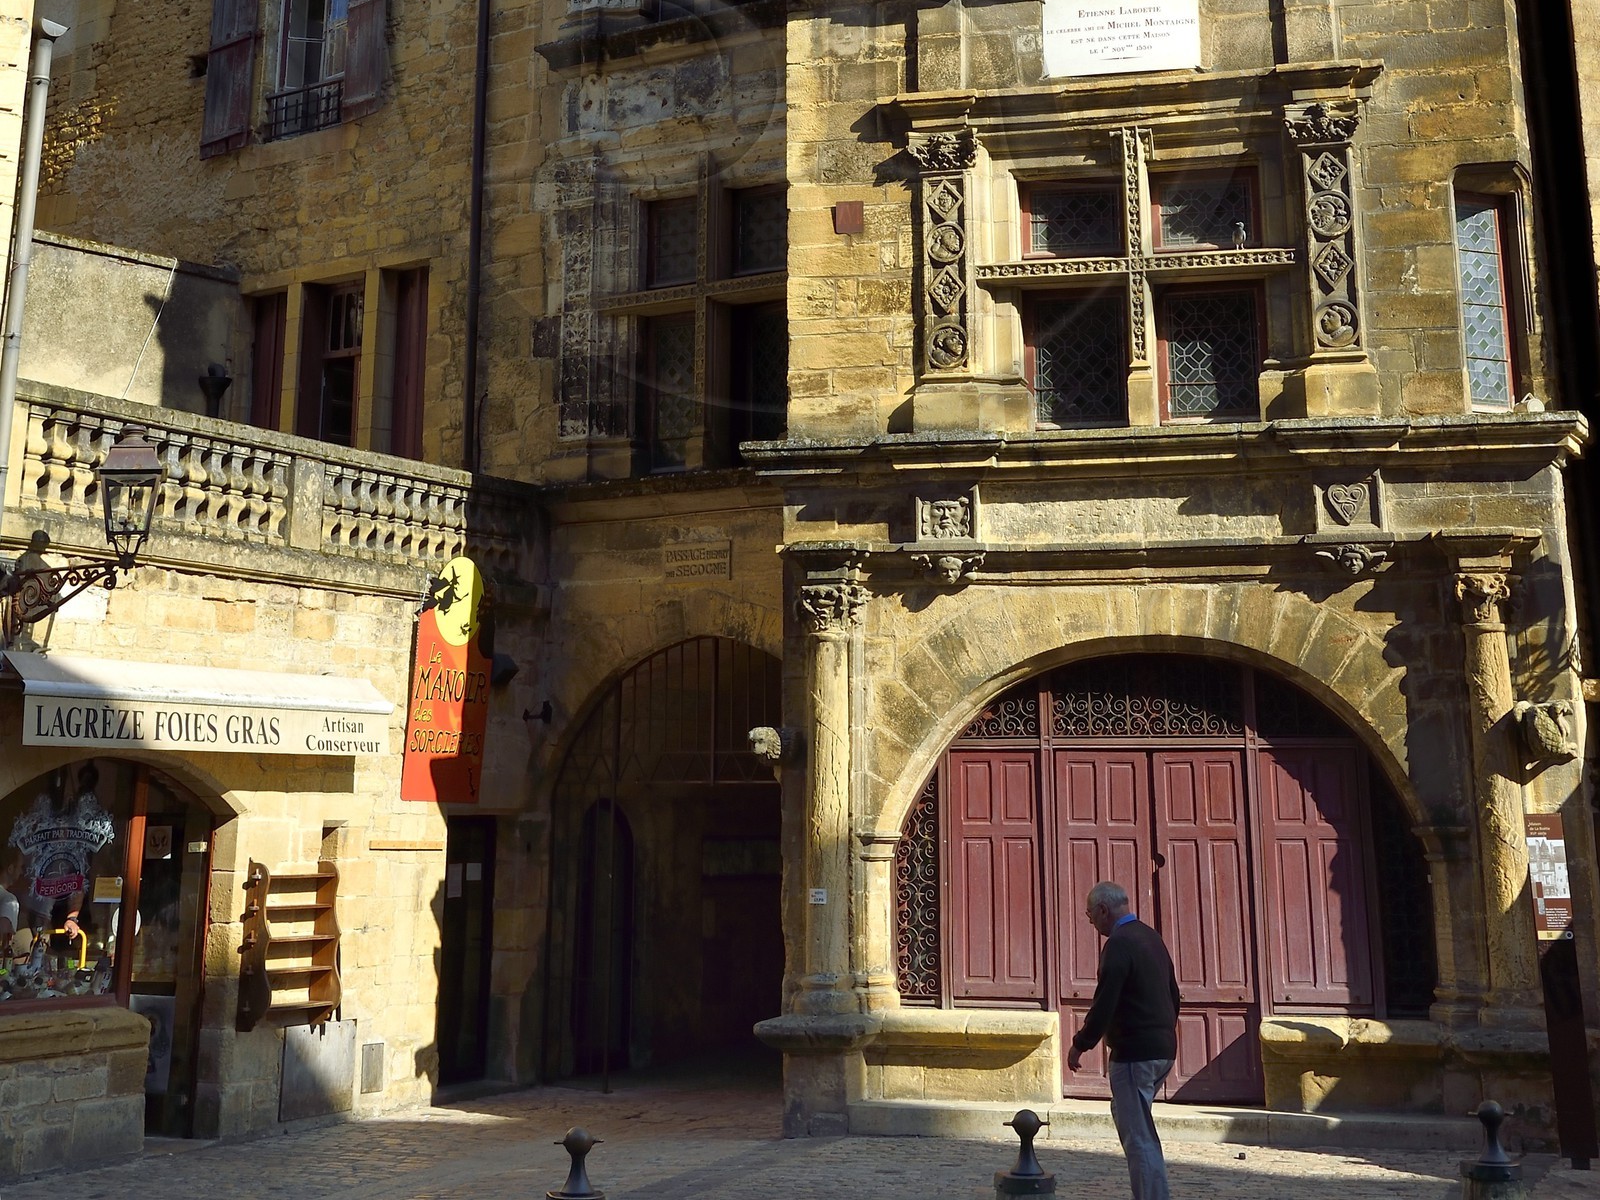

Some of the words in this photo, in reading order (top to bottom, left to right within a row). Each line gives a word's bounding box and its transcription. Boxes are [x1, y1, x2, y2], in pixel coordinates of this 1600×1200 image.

[1107, 20, 1141, 30] MICHEL
[1144, 17, 1196, 27] MONTAIGNE
[1143, 31, 1171, 39] MAISON
[665, 547, 706, 563] PASSAGE
[414, 666, 487, 704] MANOIR
[413, 701, 433, 722] des
[35, 705, 145, 740] LAGRÈZE
[154, 711, 218, 743] FOIES
[226, 715, 280, 746] GRAS
[322, 716, 364, 733] Artisan
[306, 734, 380, 753] Conserveur
[410, 728, 482, 756] SORCIÈRES
[24, 831, 50, 846] PARFAIT
[52, 829, 65, 839] PAR
[66, 829, 100, 844] TRADITION
